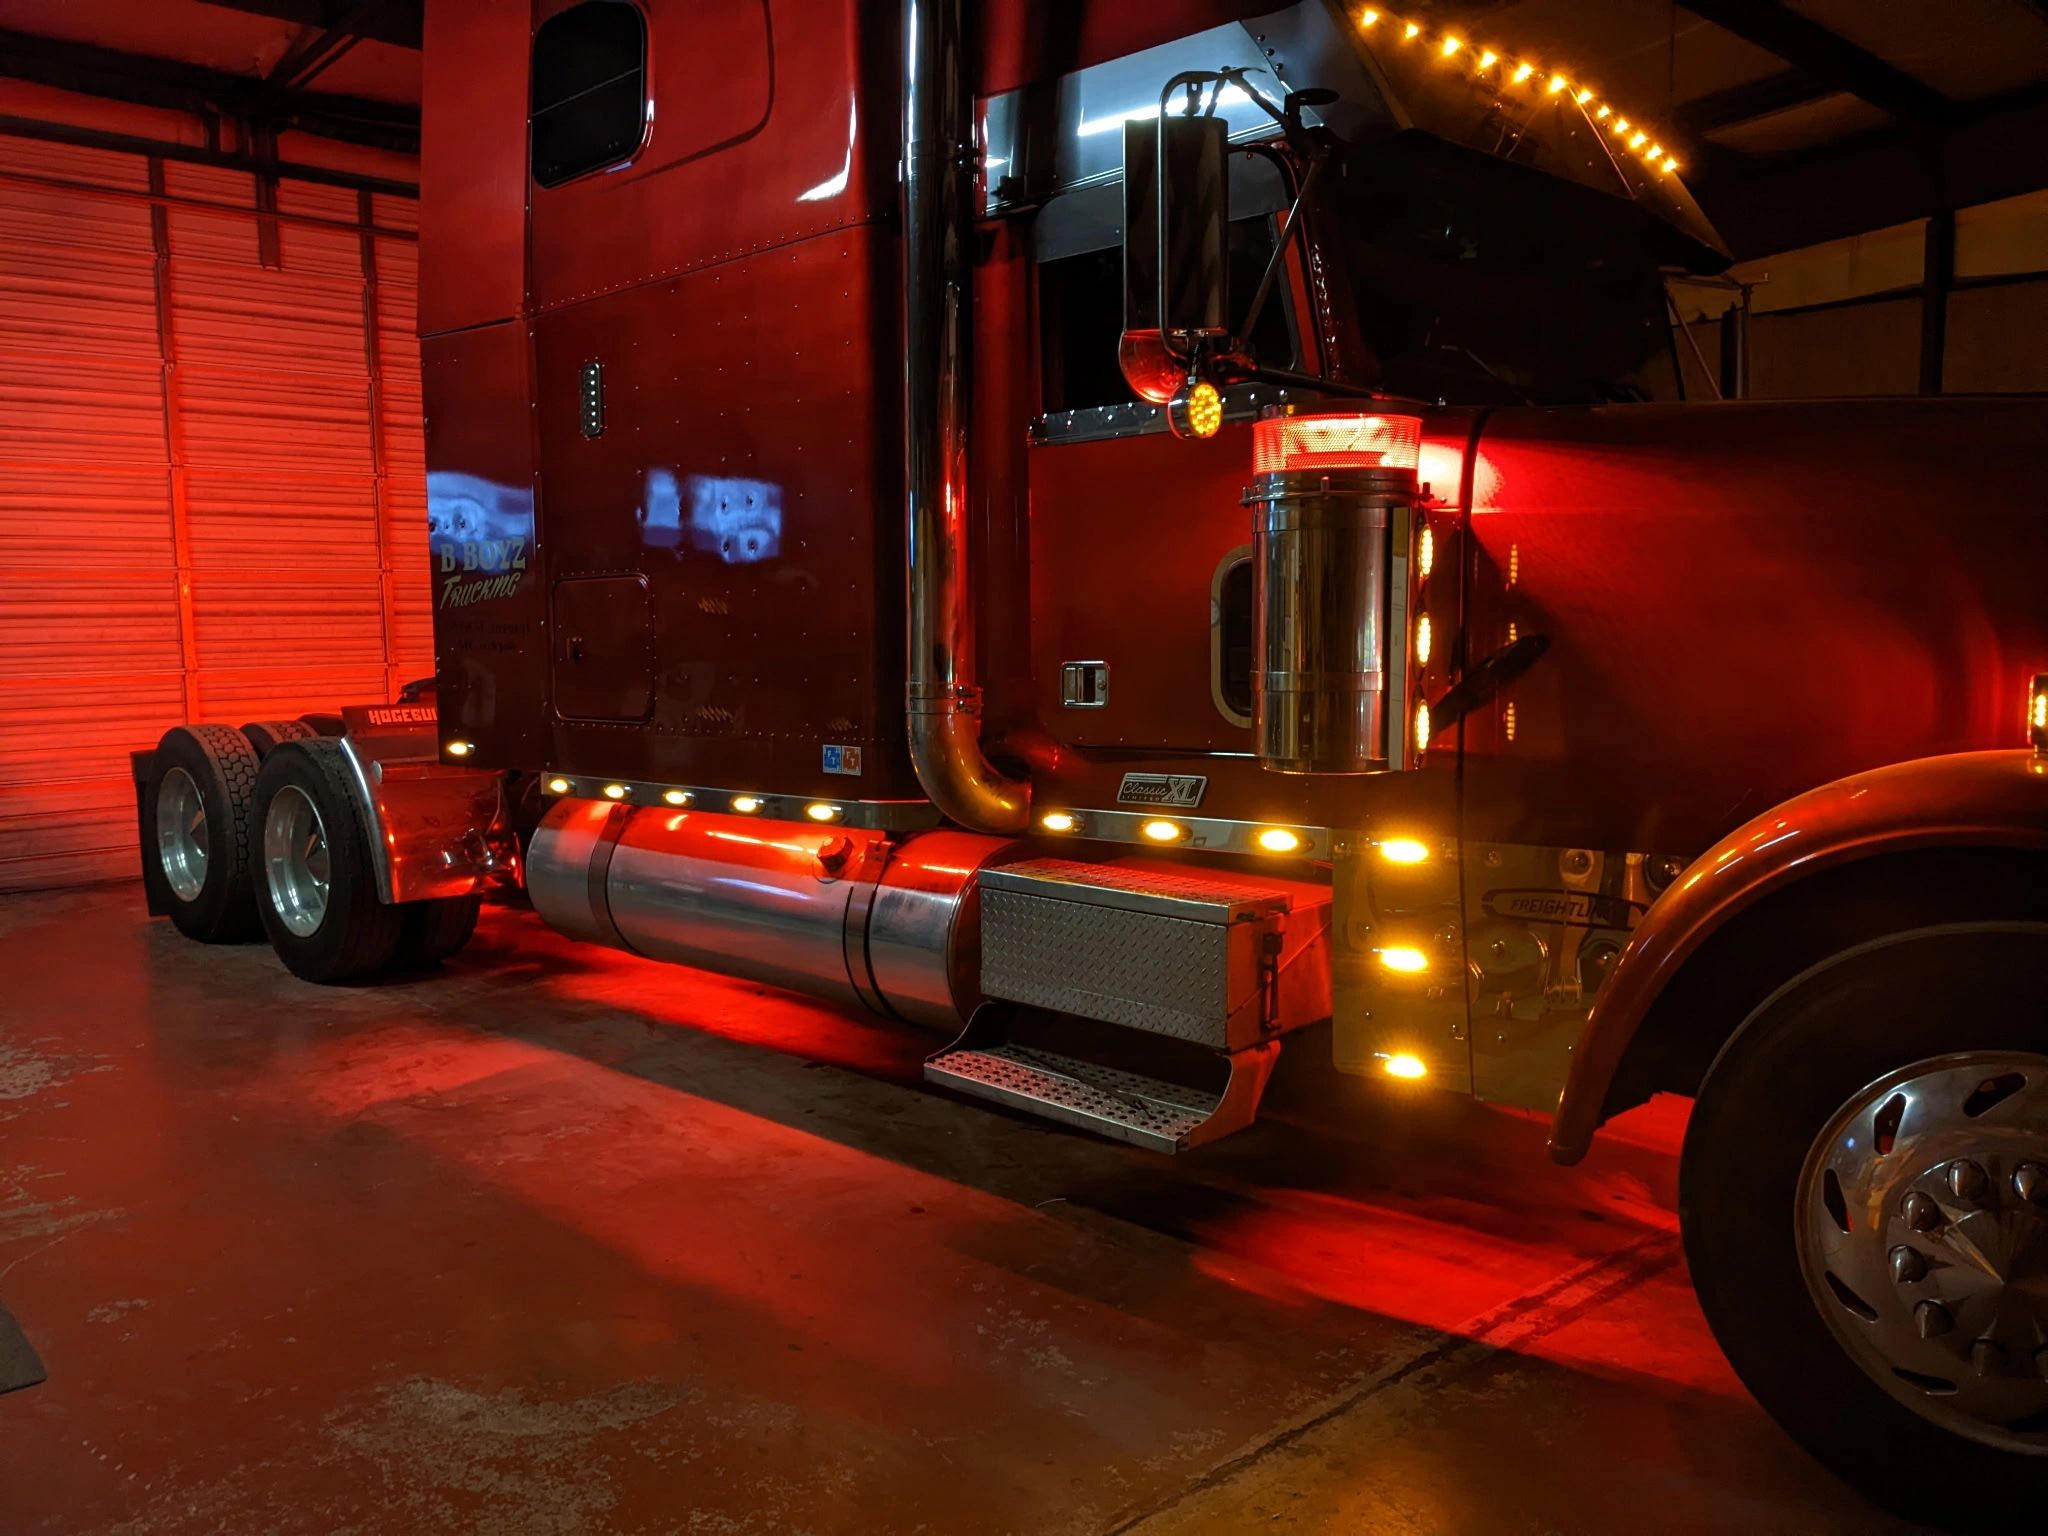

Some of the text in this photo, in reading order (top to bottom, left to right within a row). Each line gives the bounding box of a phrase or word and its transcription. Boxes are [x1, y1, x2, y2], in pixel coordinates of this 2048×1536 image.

[440, 536, 526, 573] B BOYZ
[1122, 778, 1197, 804] Classic XL
